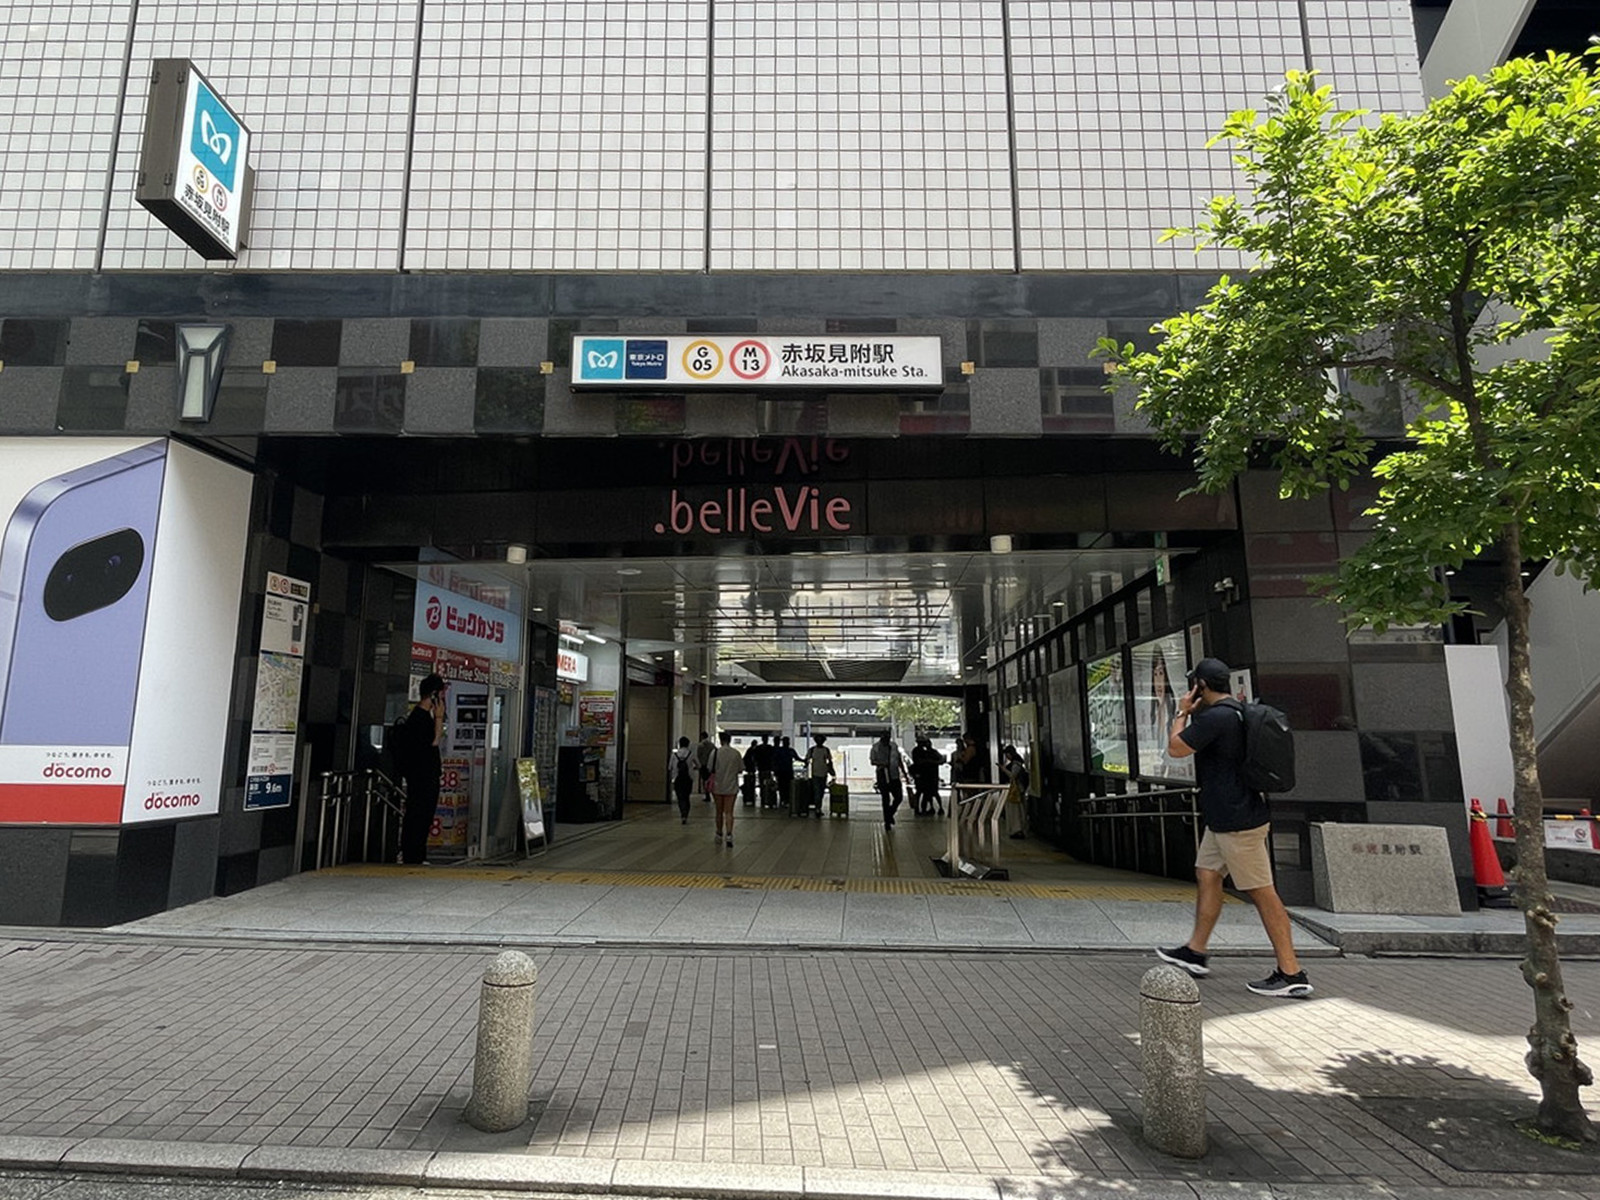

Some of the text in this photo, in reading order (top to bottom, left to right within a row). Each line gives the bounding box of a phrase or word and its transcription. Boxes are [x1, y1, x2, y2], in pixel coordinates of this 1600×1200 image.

[697, 346, 709, 358] G
[743, 347, 757, 357] M
[782, 343, 894, 364] 赤坂見附駅
[693, 359, 712, 371] 05
[742, 359, 760, 371] 13
[782, 365, 928, 377] Akasaka-mitsuke Sta.
[446, 605, 505, 644] ビックカメラ
[812, 707, 877, 716] TOKYU PLAZ
[43, 762, 112, 778] docomo
[144, 792, 200, 810] docomo
